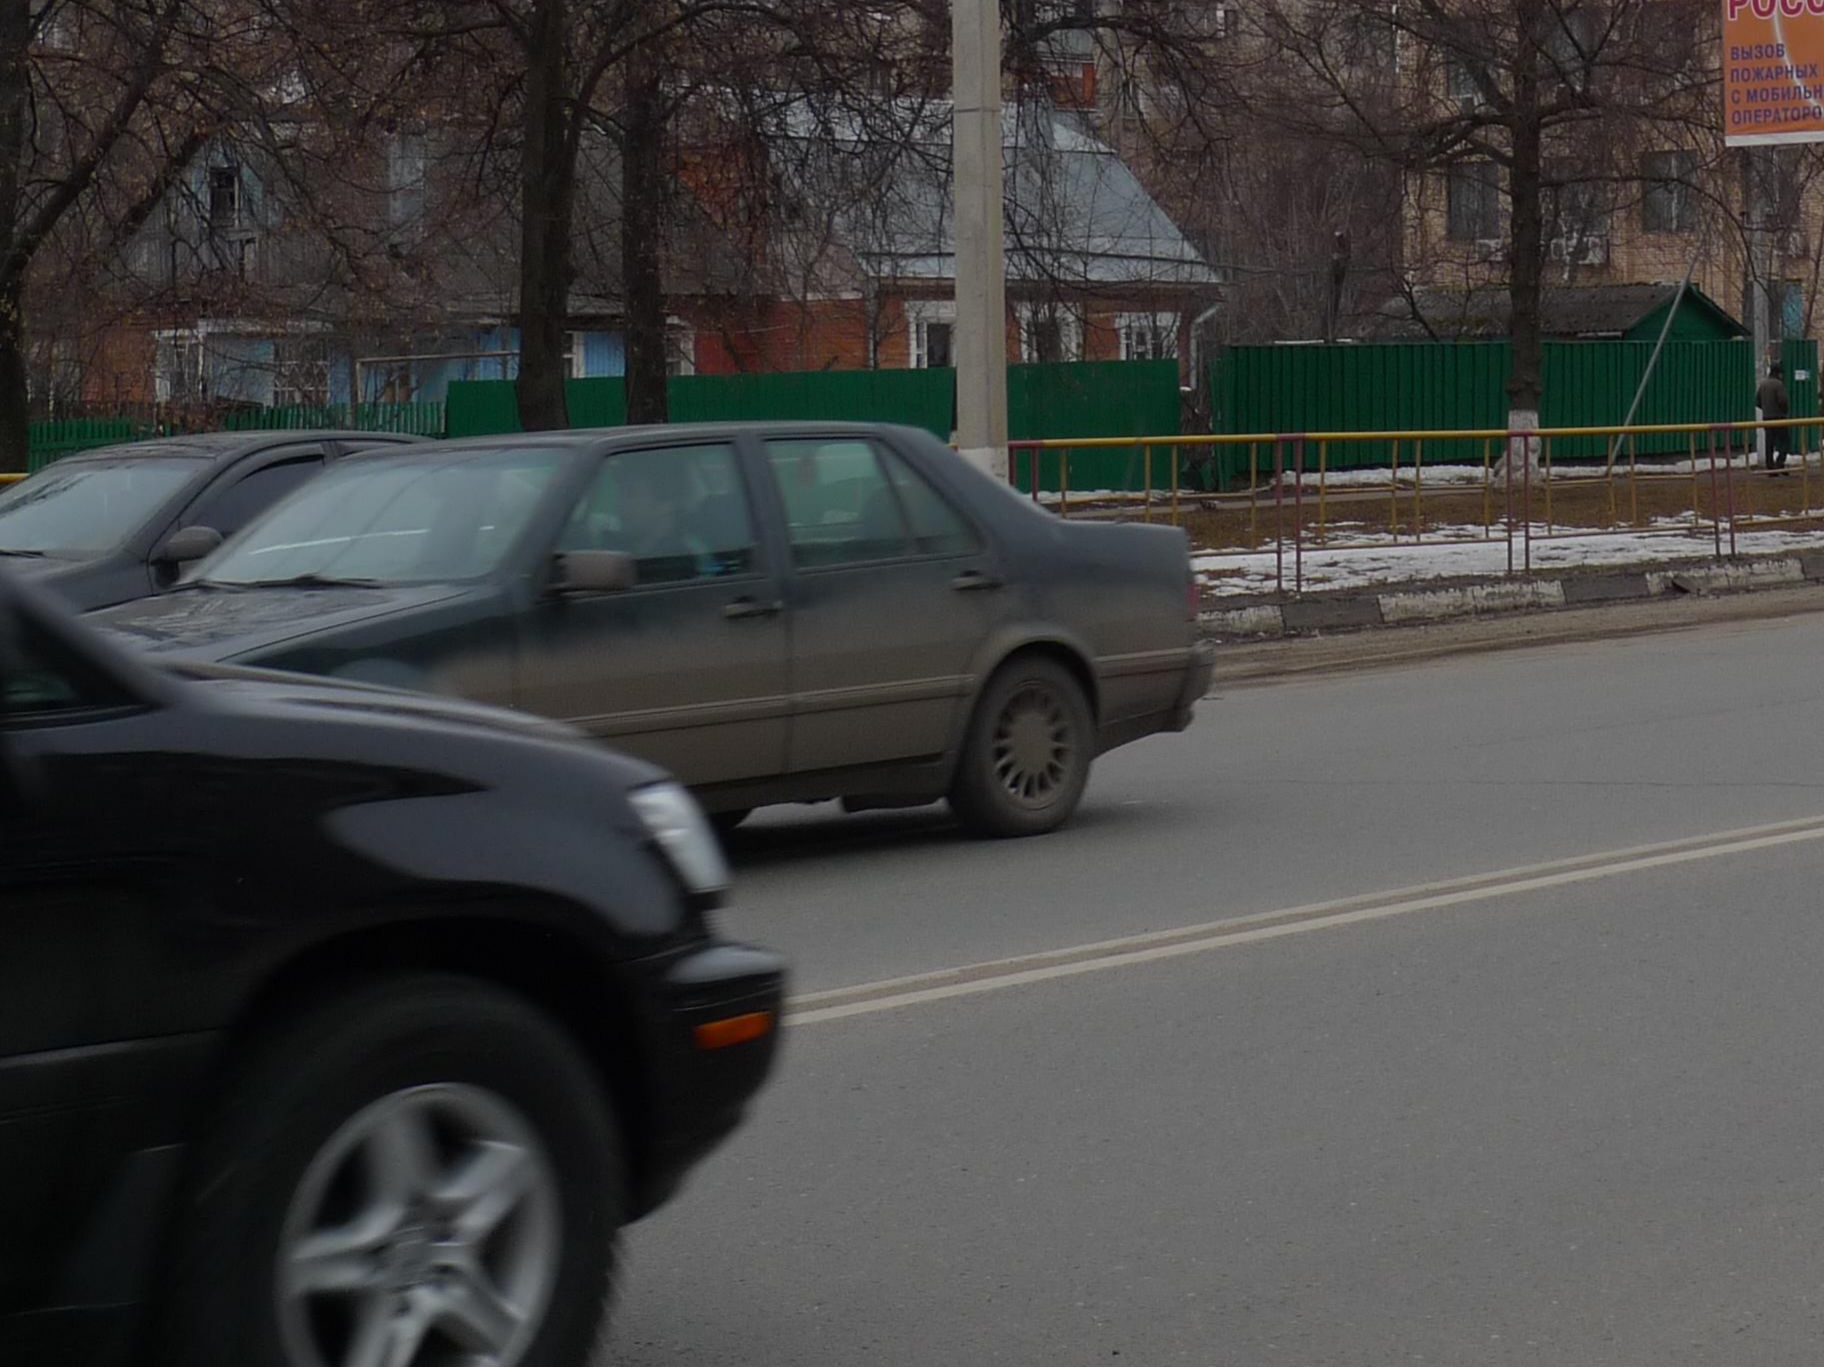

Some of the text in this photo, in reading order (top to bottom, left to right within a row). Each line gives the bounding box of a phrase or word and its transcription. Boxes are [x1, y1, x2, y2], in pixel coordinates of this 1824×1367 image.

[1730, 43, 1785, 61] ВЫЗОВ
[1731, 62, 1818, 83] ПОЖАРНЫХ
[1731, 88, 1741, 104] С
